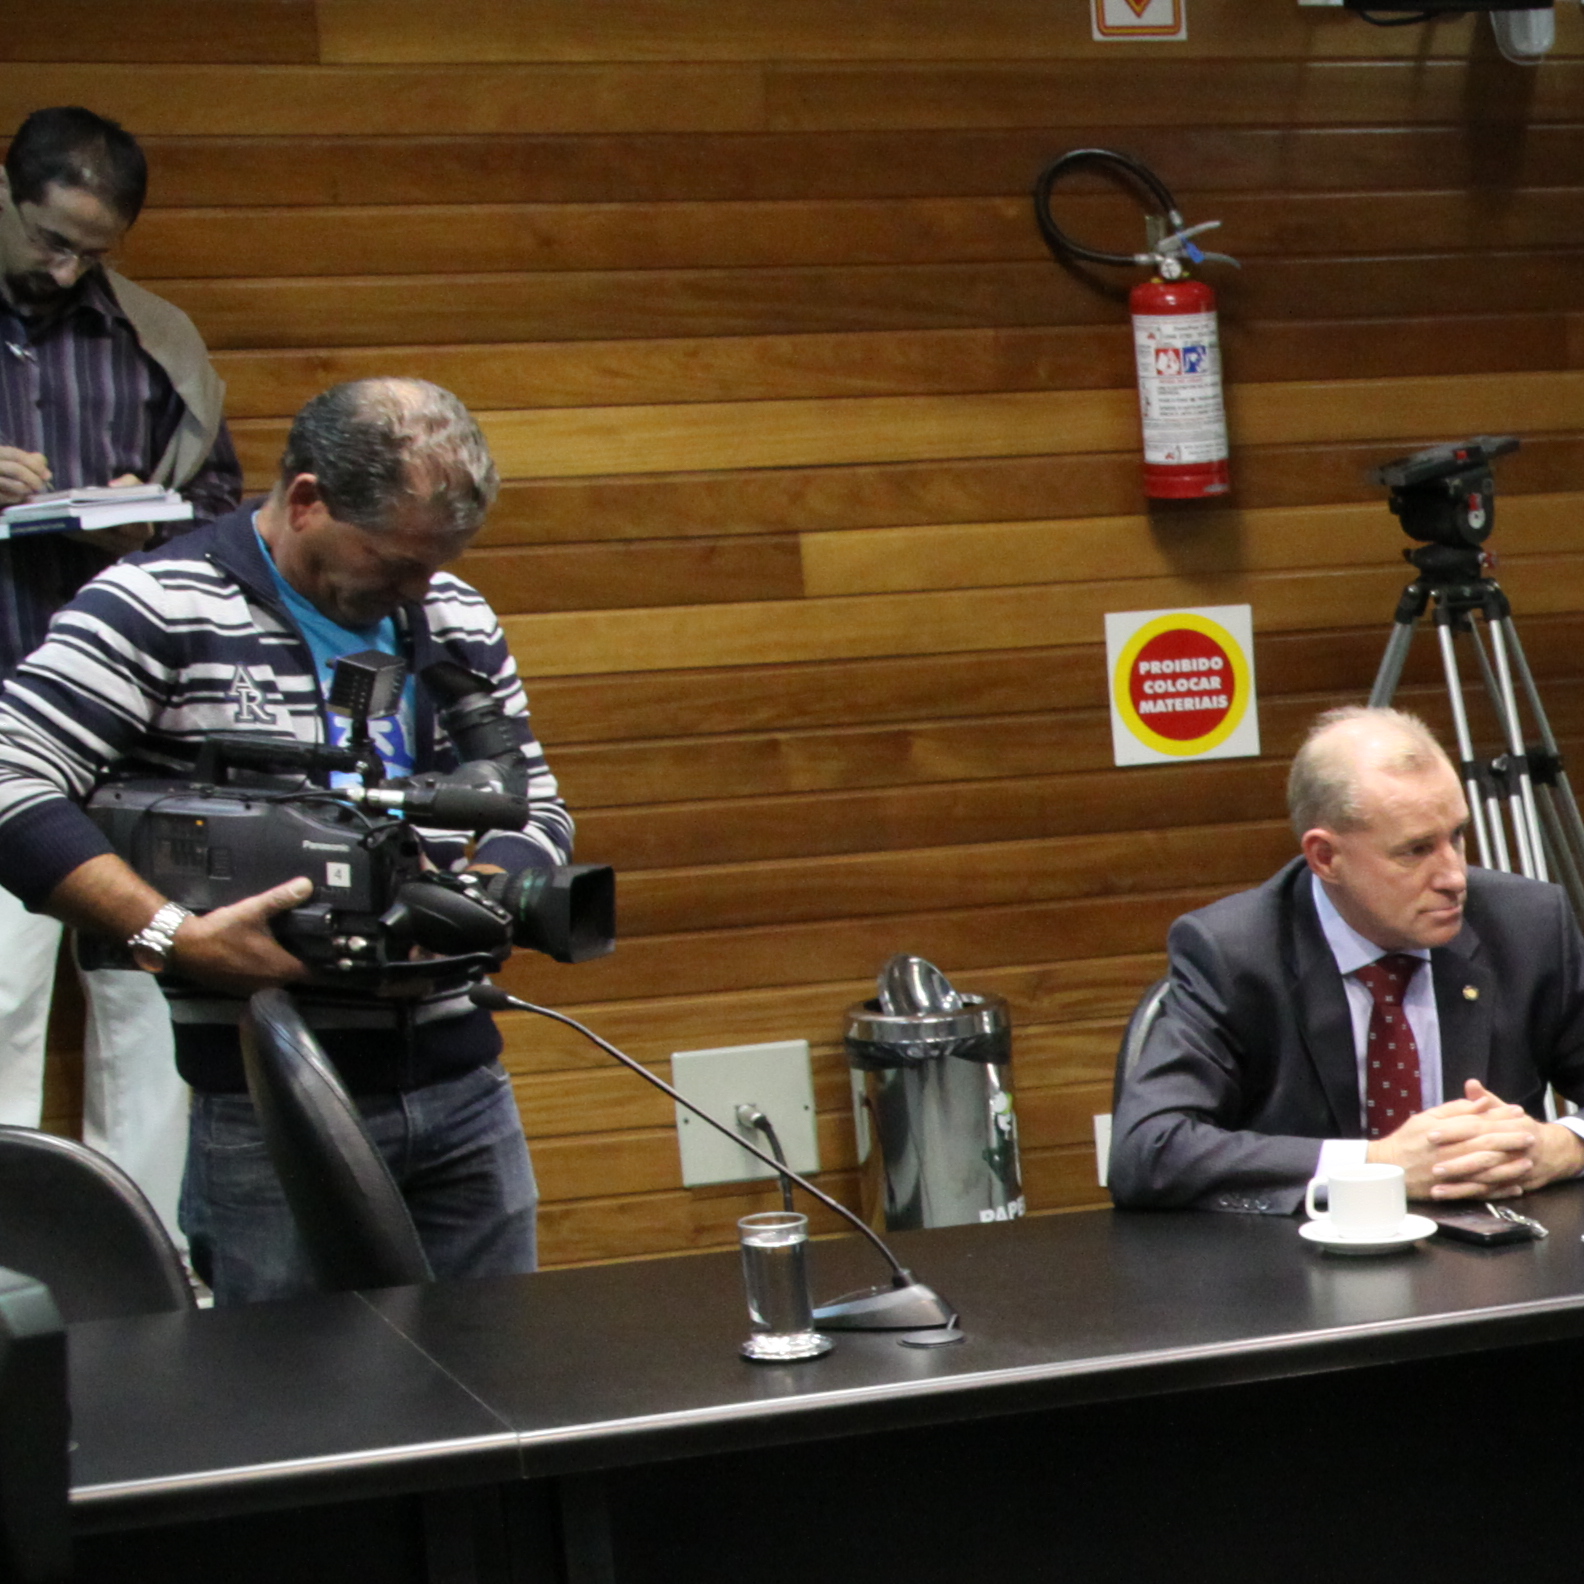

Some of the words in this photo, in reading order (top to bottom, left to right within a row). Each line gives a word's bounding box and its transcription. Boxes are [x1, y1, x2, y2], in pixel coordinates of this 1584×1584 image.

[1138, 656, 1224, 676] PROIBIDO
[1143, 676, 1222, 695] COLOCAR
[1139, 695, 1229, 714] MATERIAIS
